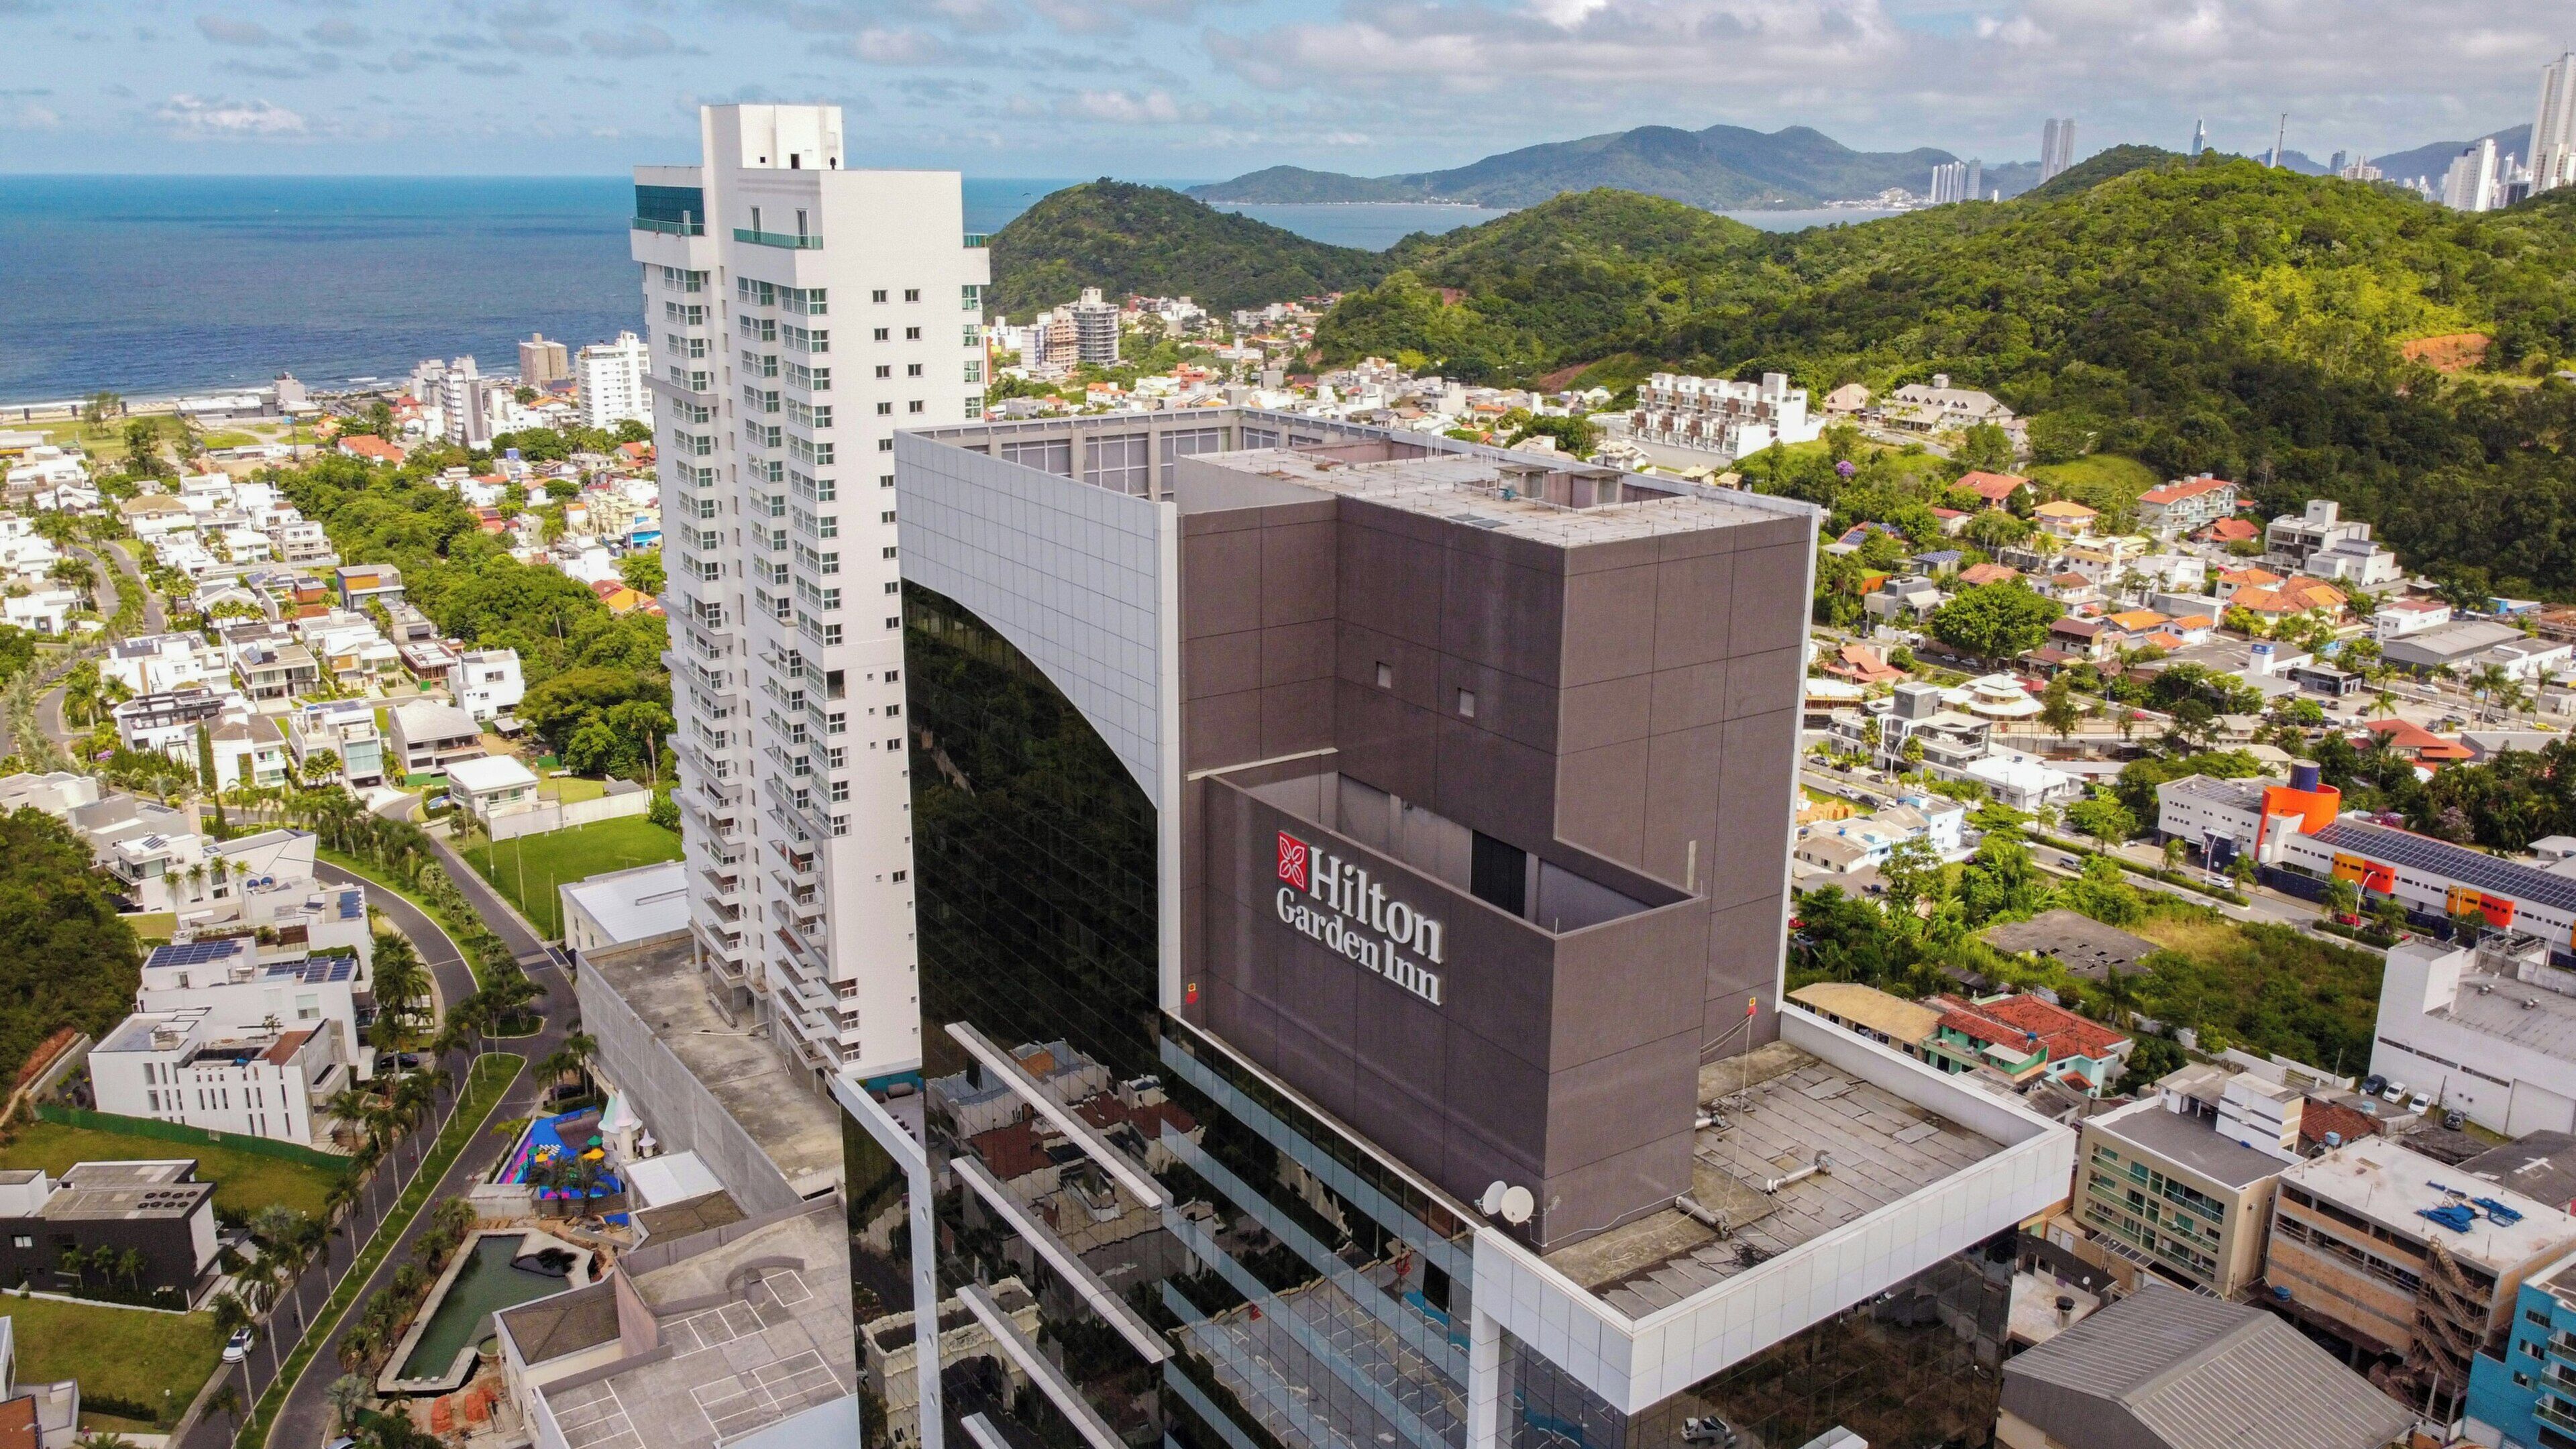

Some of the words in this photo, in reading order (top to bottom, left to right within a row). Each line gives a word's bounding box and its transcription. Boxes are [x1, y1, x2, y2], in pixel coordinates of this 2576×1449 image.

[1277, 888, 1380, 973] Garden
[1383, 940, 1441, 1006] Inn
[1310, 847, 1442, 964] Hilton
